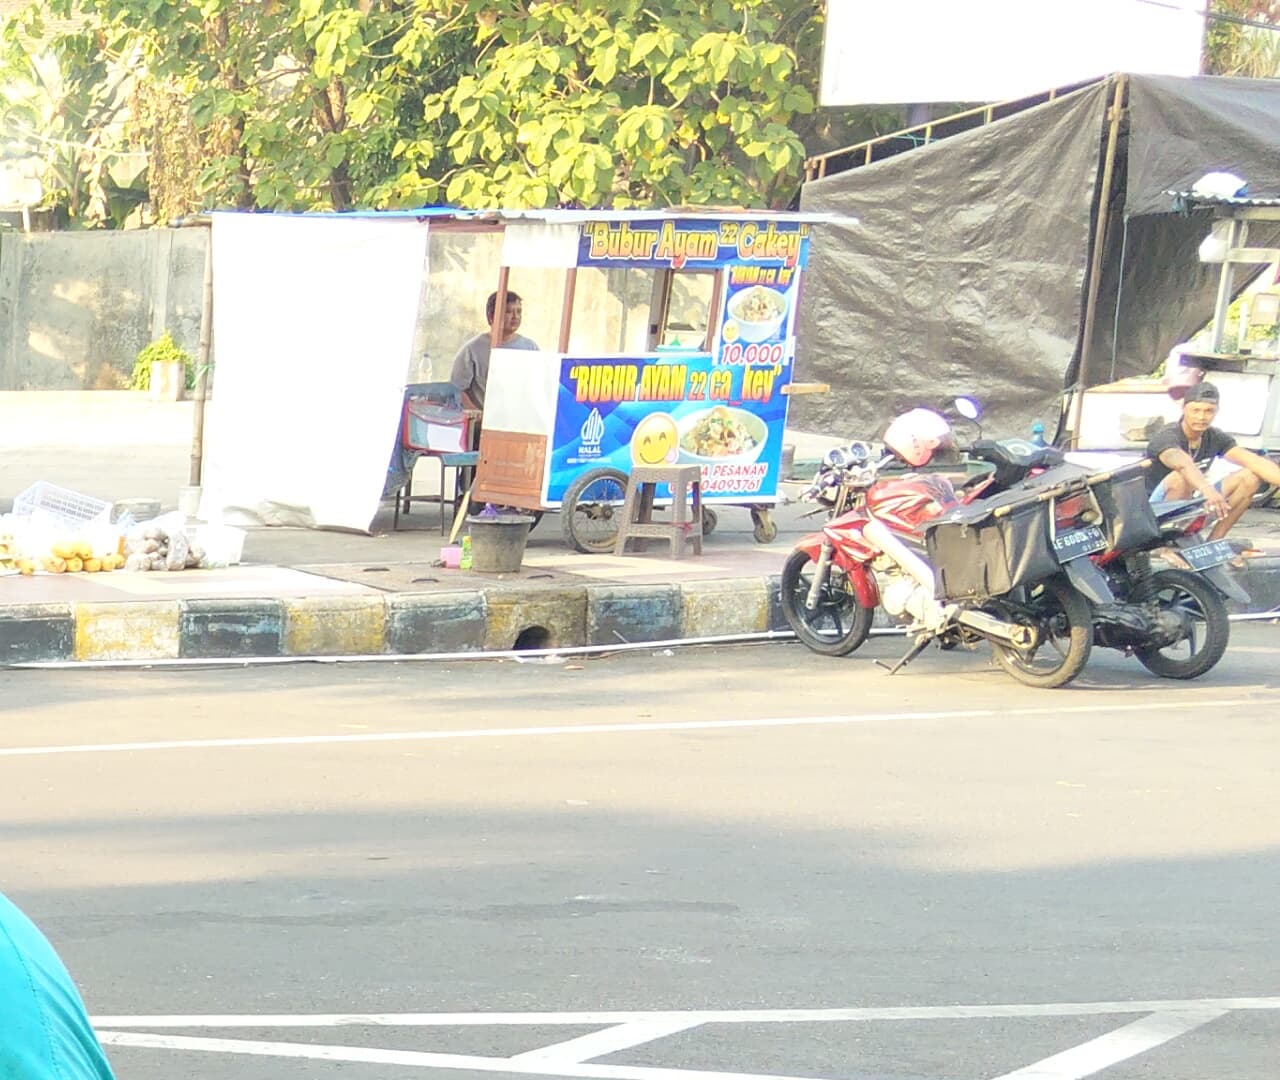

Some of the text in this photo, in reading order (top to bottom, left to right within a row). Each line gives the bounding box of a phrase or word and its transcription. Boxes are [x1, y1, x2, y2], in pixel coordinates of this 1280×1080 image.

[655, 221, 717, 267] Ayam
[720, 223, 738, 244] 22
[723, 345, 782, 364] 10.000
[639, 365, 687, 401] AYAM
[688, 371, 707, 400] 22
[713, 465, 766, 477] PESANAN
